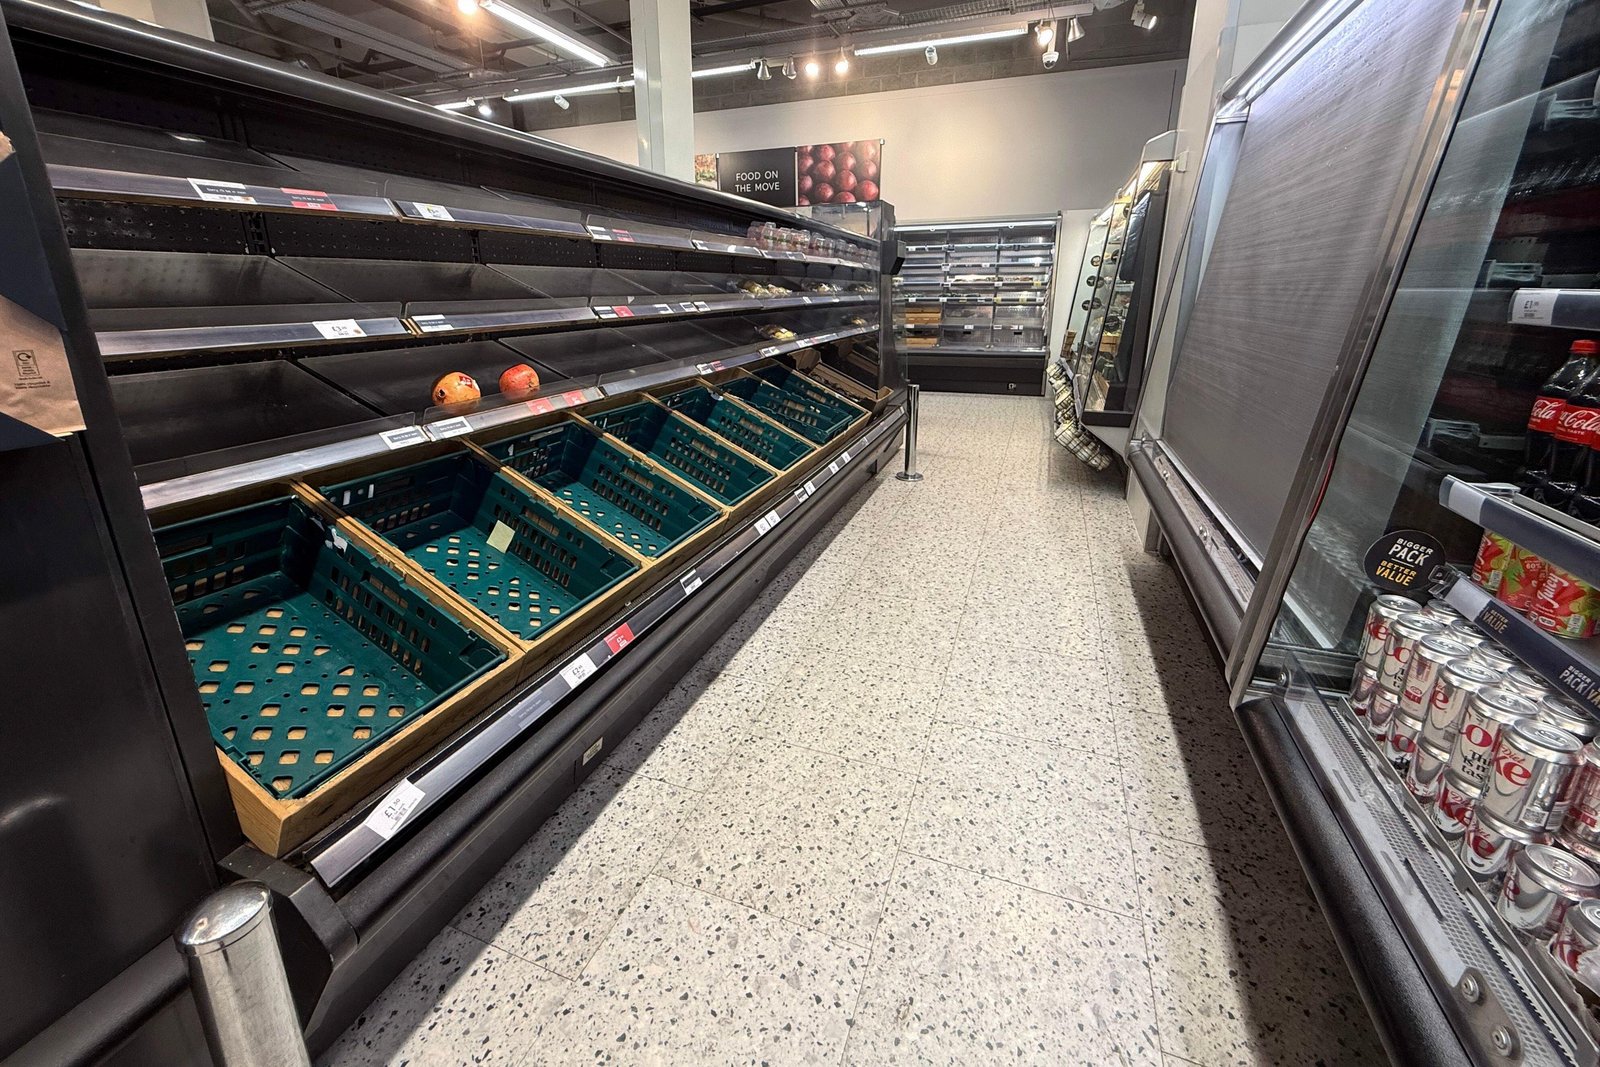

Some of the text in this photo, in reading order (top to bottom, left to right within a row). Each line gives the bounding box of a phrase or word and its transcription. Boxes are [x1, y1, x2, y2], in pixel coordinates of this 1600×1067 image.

[736, 170, 779, 181] FOOD ON
[735, 182, 780, 193] THE MOVE
[1388, 543, 1430, 566] PACK
[1396, 537, 1434, 555] BIGGER
[1375, 565, 1414, 587] VALUE
[1380, 560, 1417, 577] BETTER
[1536, 572, 1569, 609] Juicy
[1483, 611, 1508, 634] VALUE
[1559, 669, 1589, 695] PACK
[1567, 665, 1592, 684] BIGGER
[1501, 744, 1526, 764] Diet
